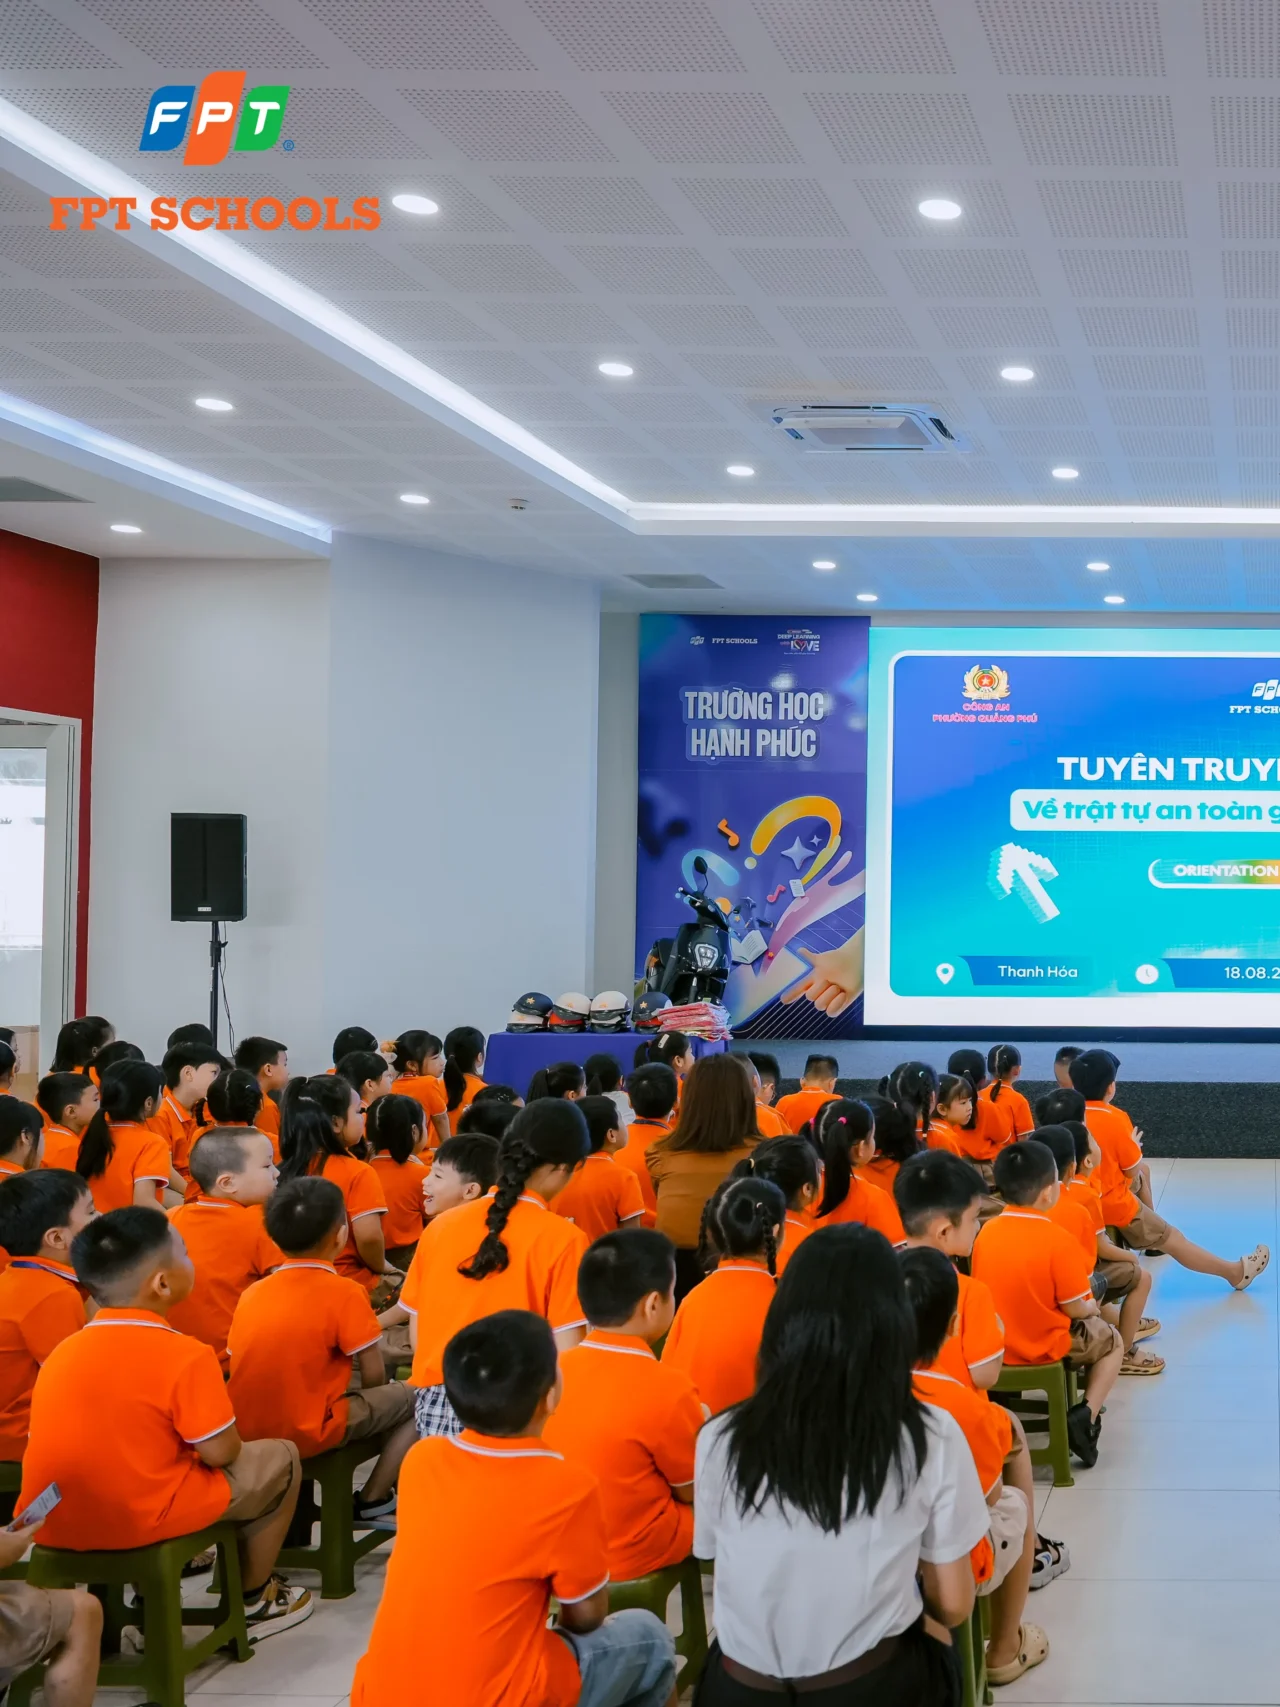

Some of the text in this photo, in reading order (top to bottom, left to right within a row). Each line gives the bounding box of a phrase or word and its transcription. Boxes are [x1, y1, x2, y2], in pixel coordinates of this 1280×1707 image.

[685, 687, 824, 724] TRƯỜNG HỌC
[995, 703, 1010, 711] AN
[1229, 705, 1252, 714] FPT
[691, 725, 817, 760] HẠNH PHÚC
[1057, 752, 1174, 781] TUYÊN
[1023, 797, 1058, 819] Về
[1063, 800, 1117, 823] trật
[1121, 802, 1151, 823] tự
[1155, 804, 1194, 820] an
[1197, 801, 1263, 820] toàn
[1173, 864, 1279, 877] ORIENTATION
[997, 965, 1078, 978] Thanh Hóa
